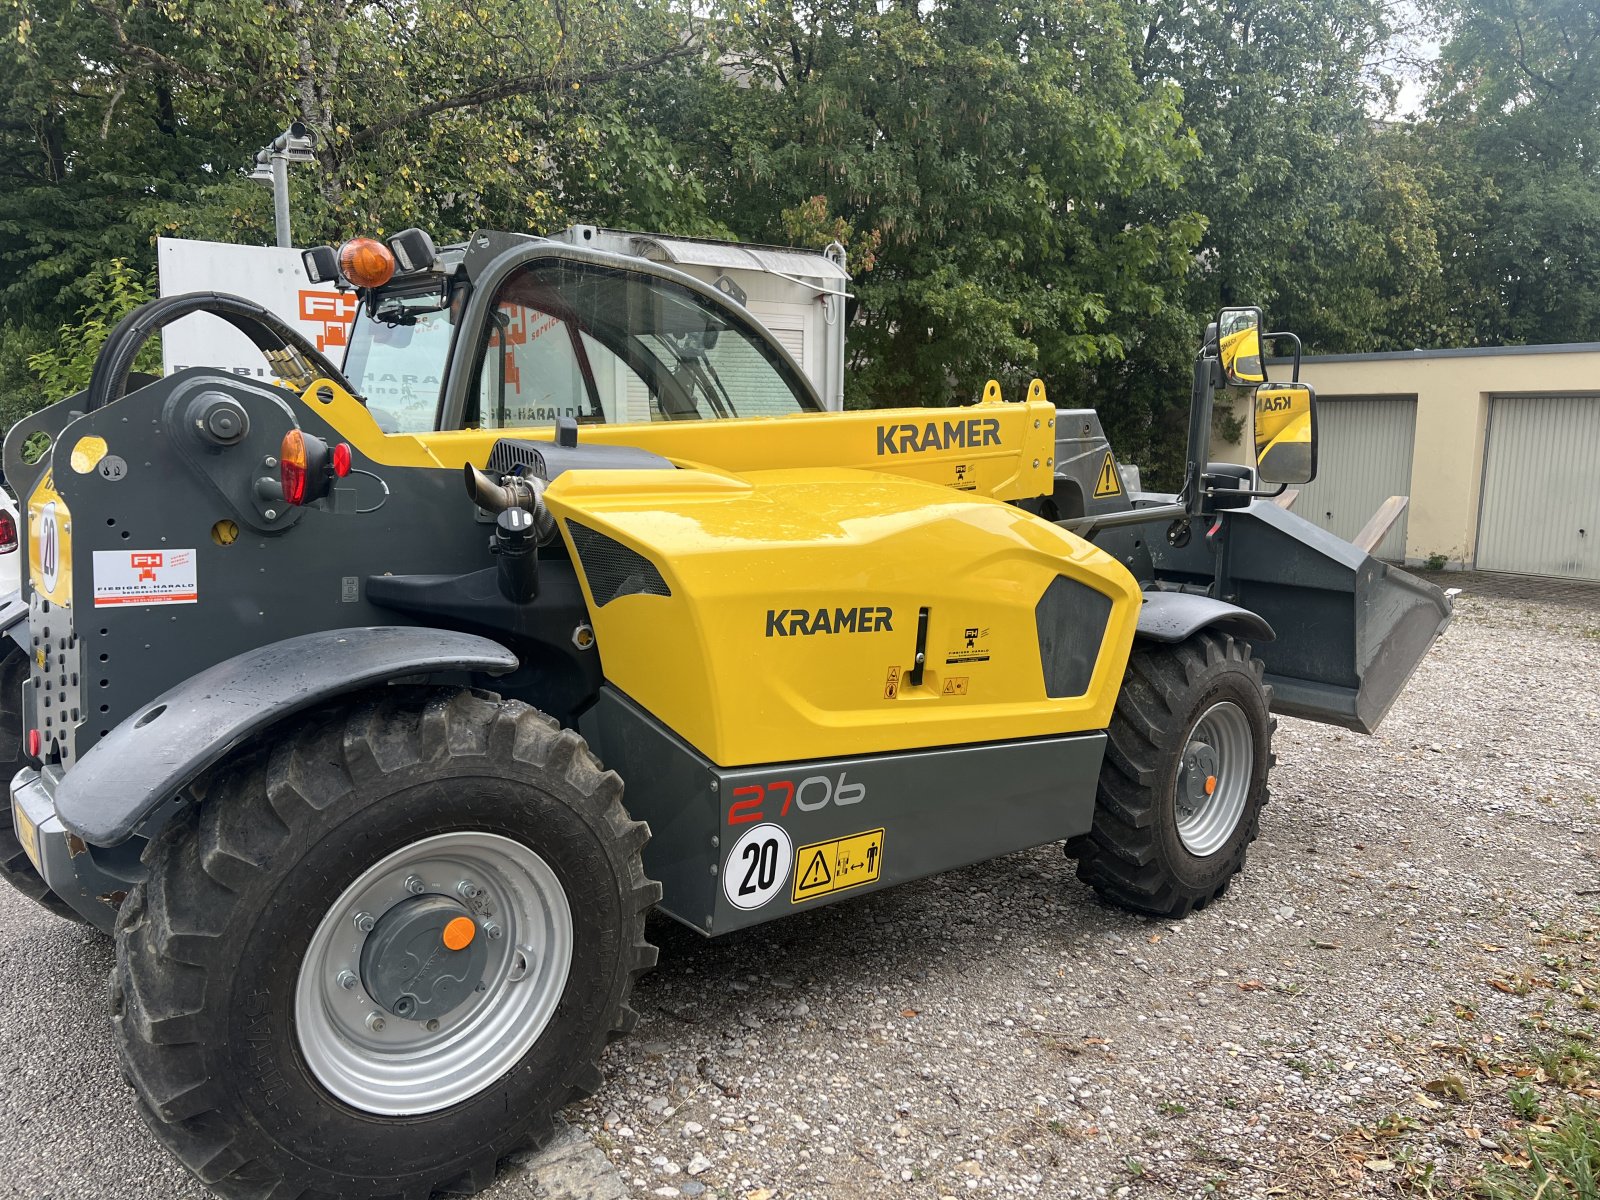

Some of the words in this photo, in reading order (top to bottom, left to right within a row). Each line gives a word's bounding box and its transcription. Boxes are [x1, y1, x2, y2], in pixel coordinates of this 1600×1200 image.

[877, 418, 1002, 456] KRAMER
[44, 517, 55, 577] 20
[134, 556, 160, 565] FH
[765, 606, 894, 637] KRAMER
[728, 772, 866, 826] 2706
[738, 837, 779, 897] 20
